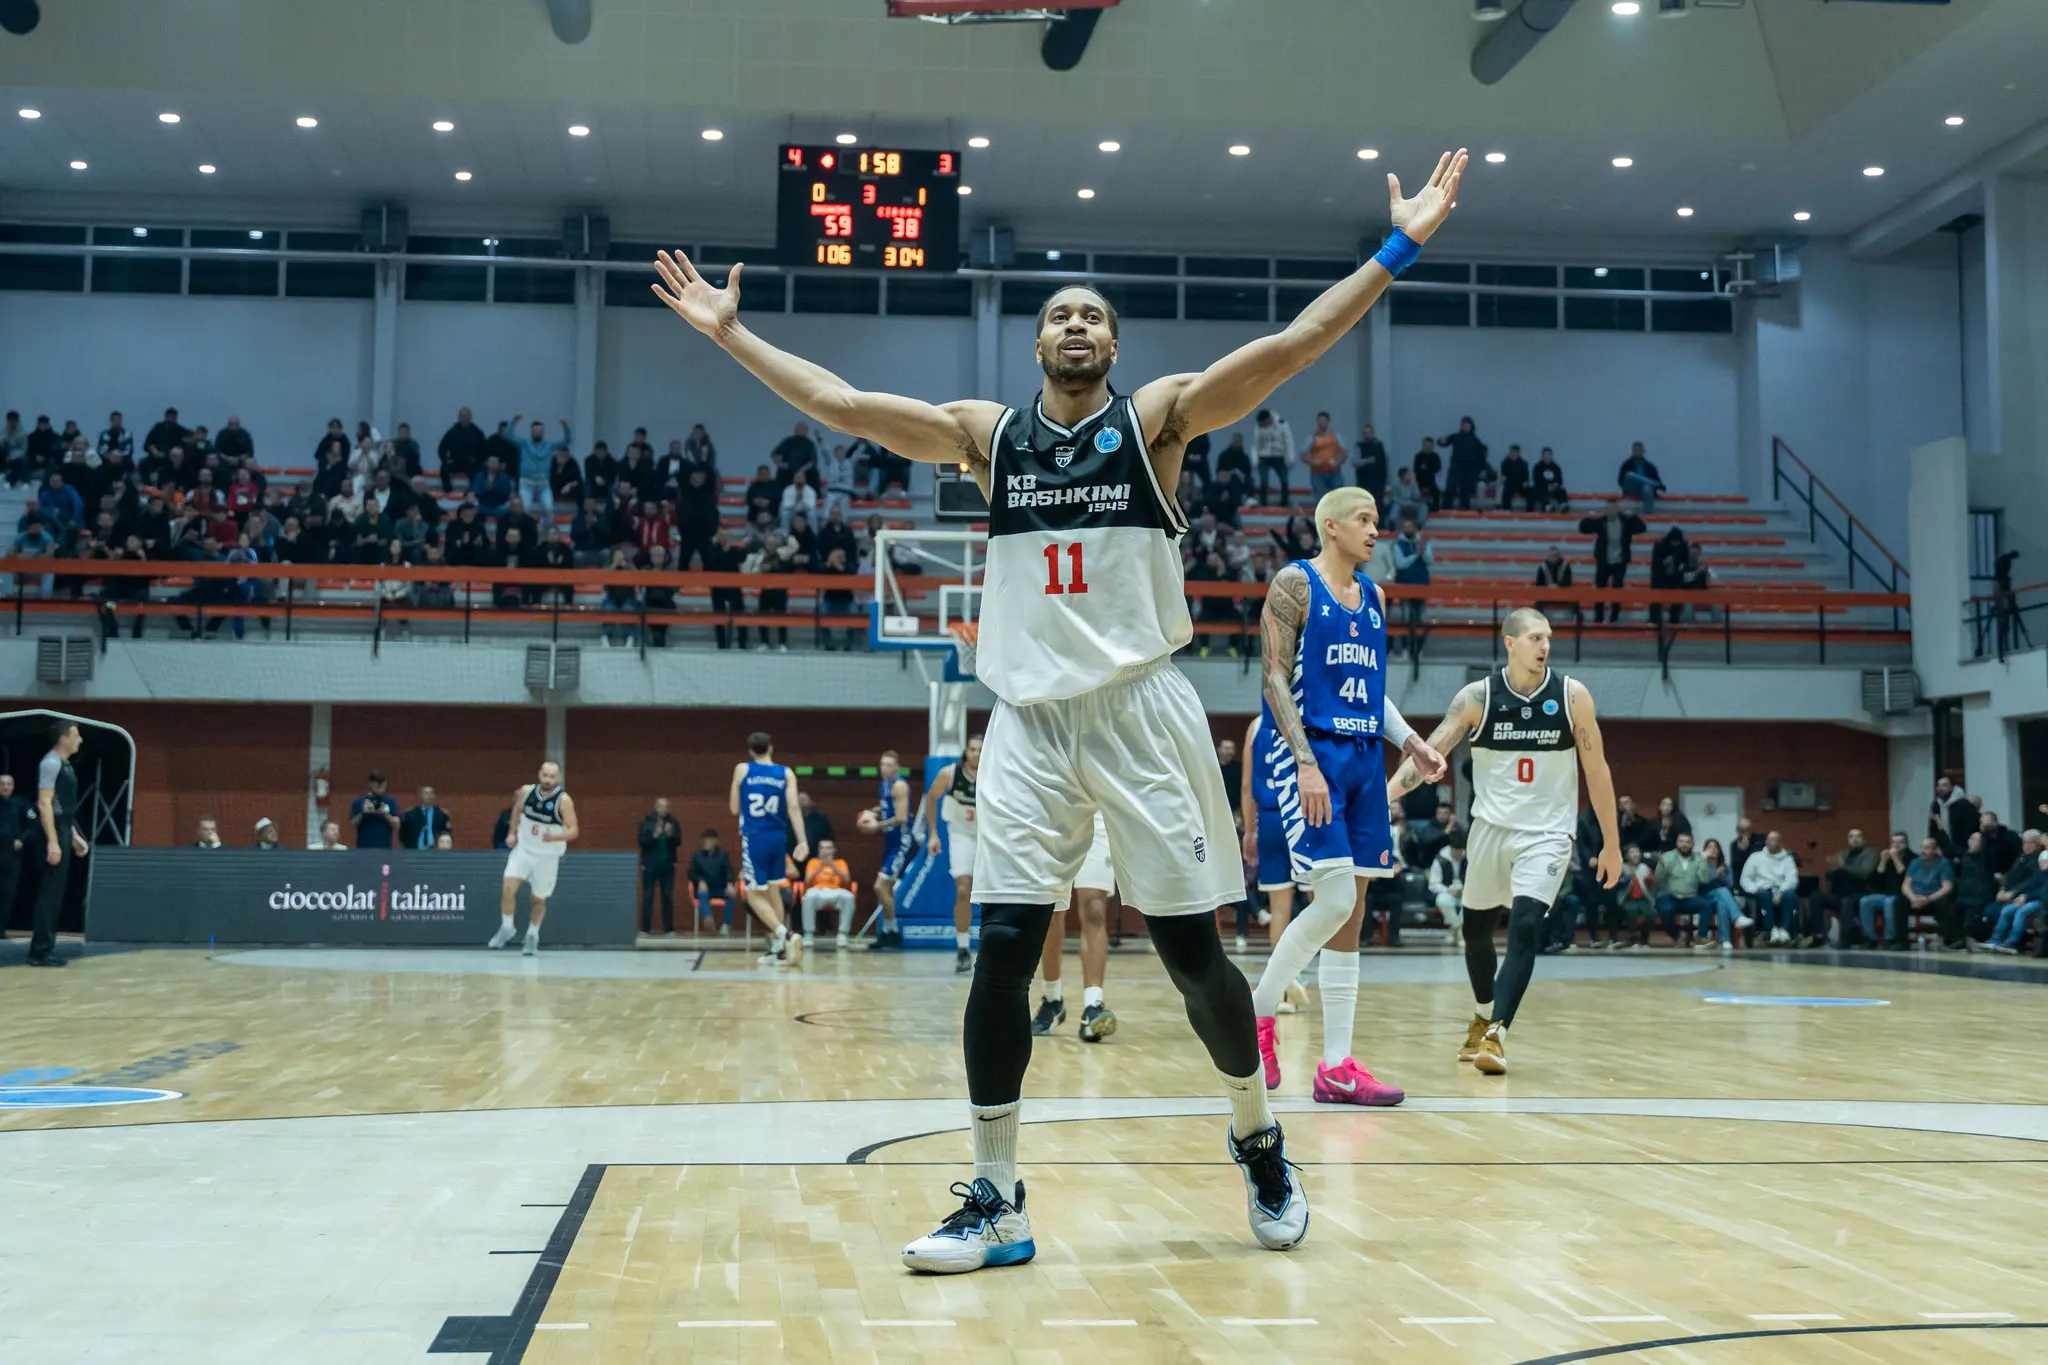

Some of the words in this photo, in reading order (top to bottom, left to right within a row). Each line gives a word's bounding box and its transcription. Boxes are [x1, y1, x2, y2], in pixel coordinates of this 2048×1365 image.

[788, 149, 802, 166] 4
[940, 153, 952, 174] 3
[812, 183, 825, 202] 0
[863, 184, 876, 204] 3
[919, 188, 926, 206] 1
[825, 215, 852, 236] 59
[893, 218, 919, 238] 38
[1006, 474, 1037, 491] KB
[1007, 484, 1131, 509] BASHKIMI
[1088, 501, 1128, 512] 1945
[1043, 542, 1088, 594] 11
[1326, 643, 1378, 670] CIBONA
[1339, 677, 1368, 704] 44
[1333, 717, 1367, 732] ERSTE
[1493, 730, 1561, 740] BASHKIMI
[1518, 758, 1534, 783] 0
[748, 793, 780, 818] 24
